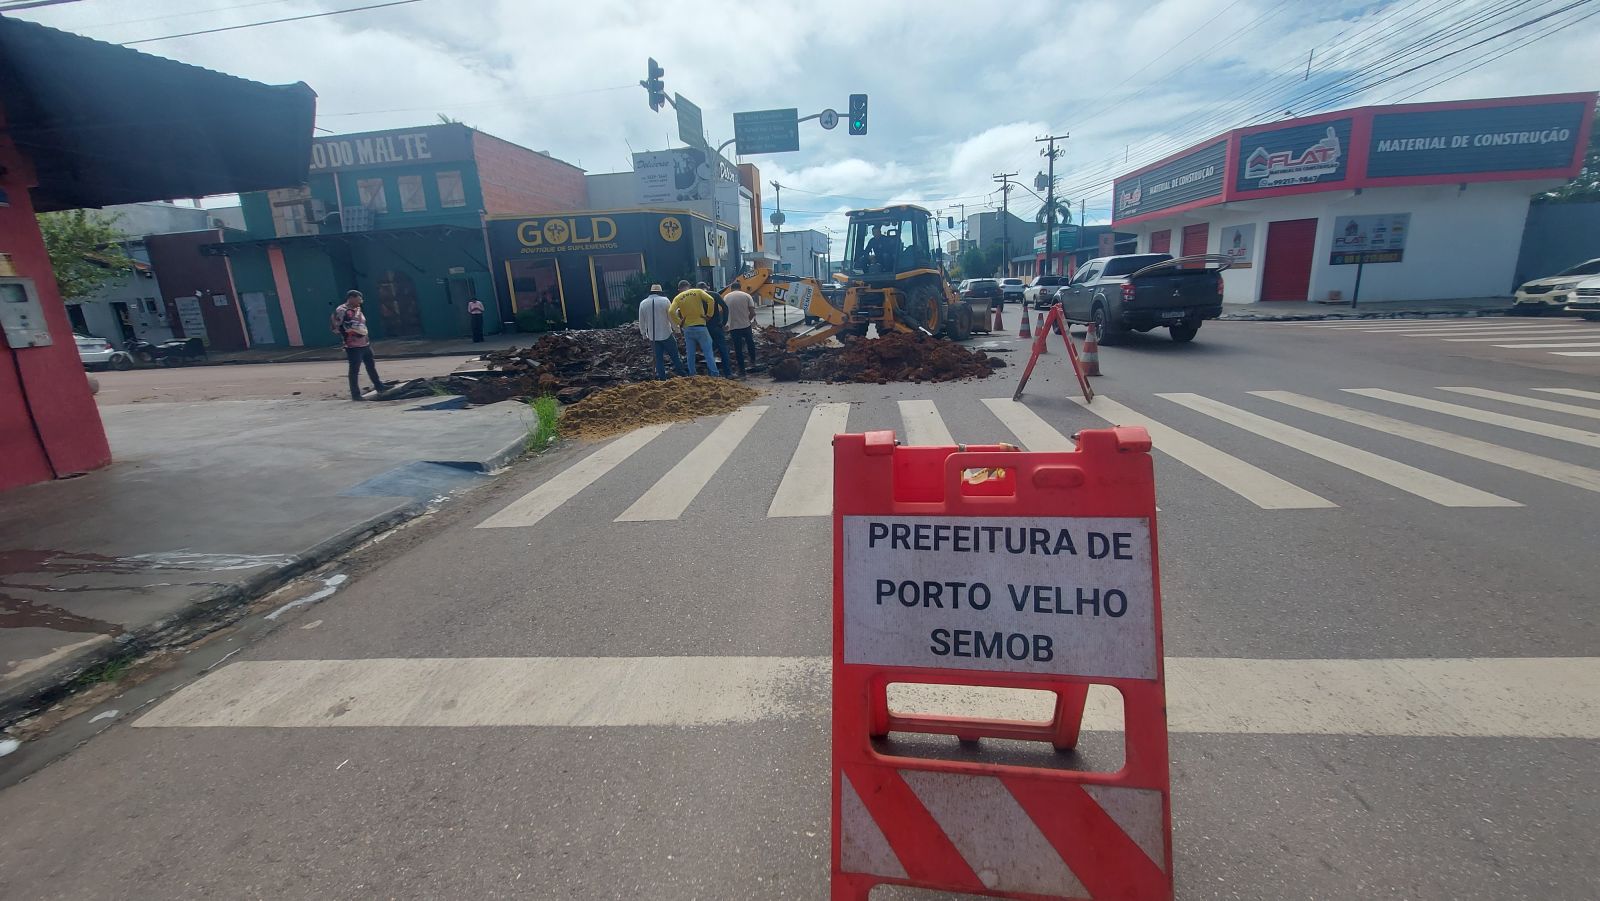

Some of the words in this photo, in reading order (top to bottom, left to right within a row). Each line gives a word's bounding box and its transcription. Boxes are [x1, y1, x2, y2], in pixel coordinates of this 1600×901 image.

[326, 141, 354, 167] DO
[355, 133, 432, 165] MALTE
[1377, 136, 1446, 152] MATERIAL
[1451, 135, 1470, 148] DE
[1473, 127, 1570, 147] CONSTRUÇÃO
[1268, 147, 1335, 170] FLAT
[1149, 181, 1170, 195] MATERIAL
[1171, 178, 1178, 188] DE
[517, 217, 617, 247] GOLD
[521, 246, 556, 254] BOUTIQUE
[567, 242, 618, 251] SUPLEMENTOS
[869, 522, 1077, 556] PREFEITURA
[1087, 531, 1133, 560] DE
[876, 579, 991, 611] PORTO
[1007, 584, 1128, 618] VELHO
[930, 628, 1054, 662] SEMOB
